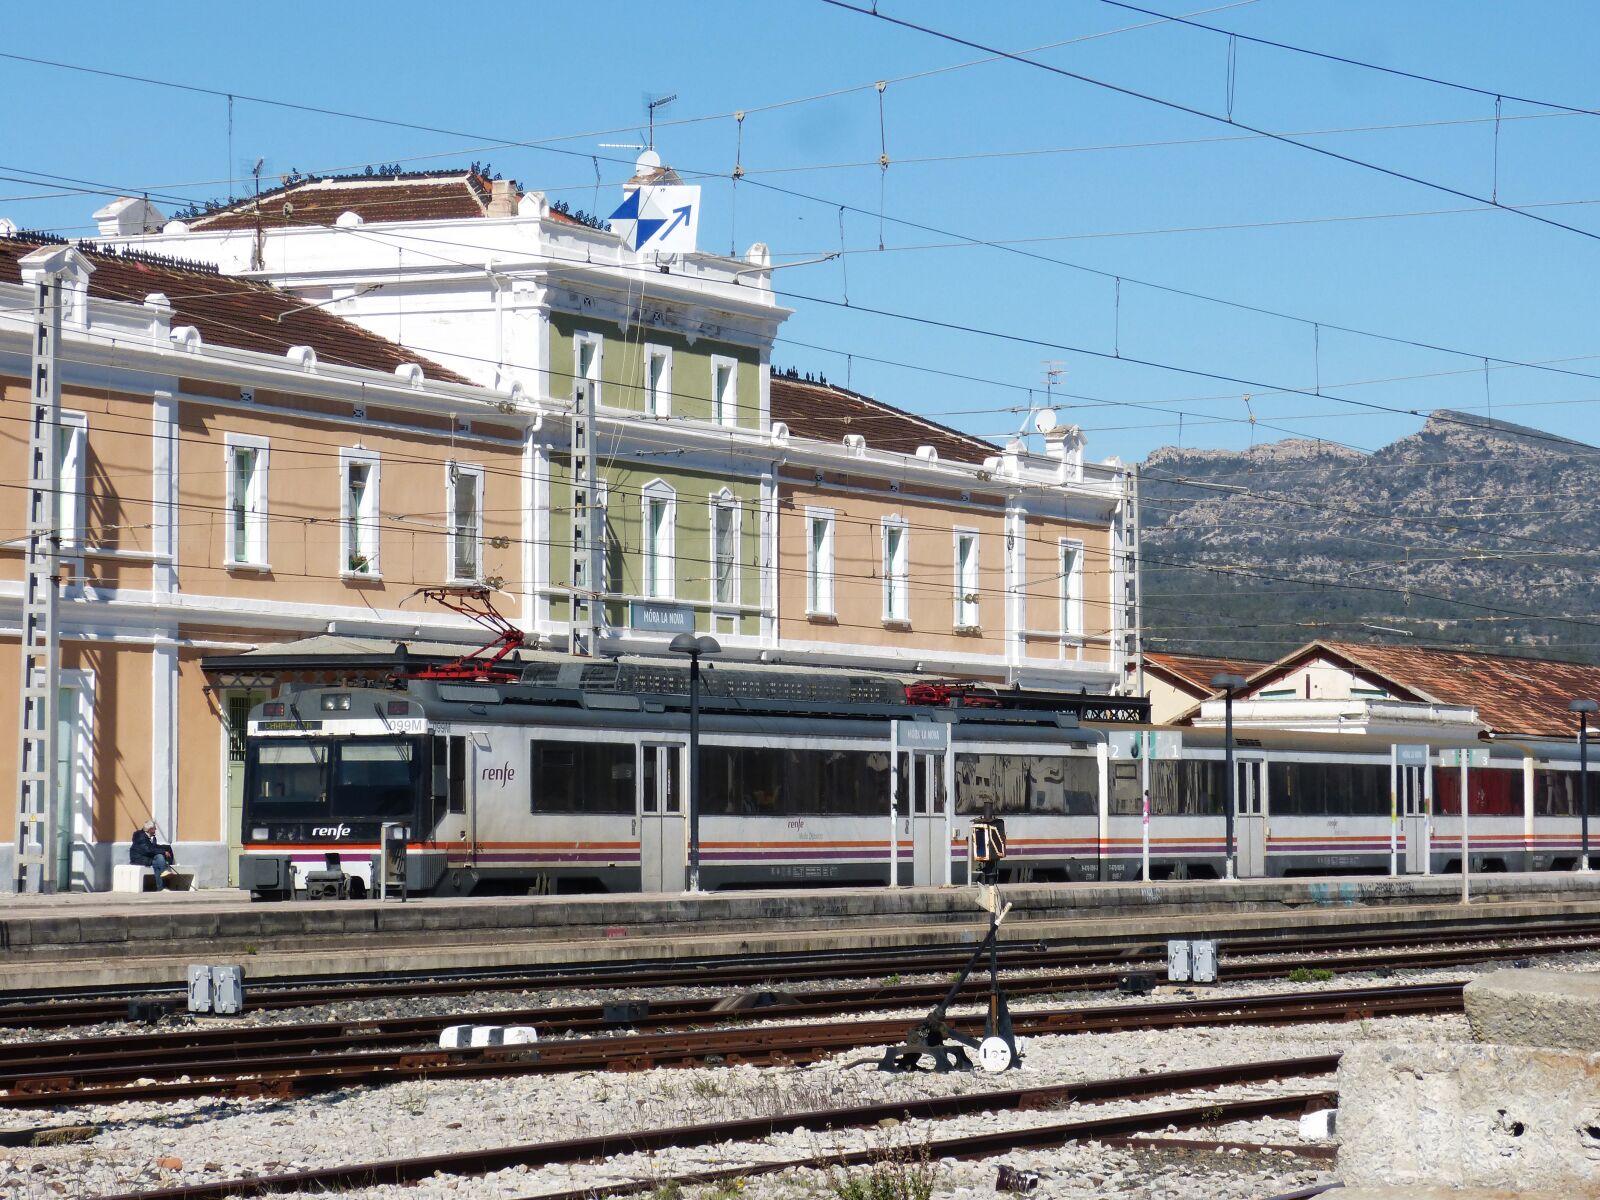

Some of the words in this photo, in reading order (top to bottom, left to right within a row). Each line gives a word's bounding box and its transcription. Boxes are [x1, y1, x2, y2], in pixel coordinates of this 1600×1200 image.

[643, 608, 660, 624] MÓRA
[660, 611, 668, 625] LA
[669, 612, 684, 625] NOVA
[389, 720, 422, 732] 099M
[1111, 744, 1119, 758] 2
[1171, 744, 1179, 758] 1
[1441, 758, 1447, 766] 1
[1481, 756, 1488, 766] 3
[481, 760, 515, 788] renfe
[311, 822, 351, 841] renfe
[787, 817, 805, 832] renfe
